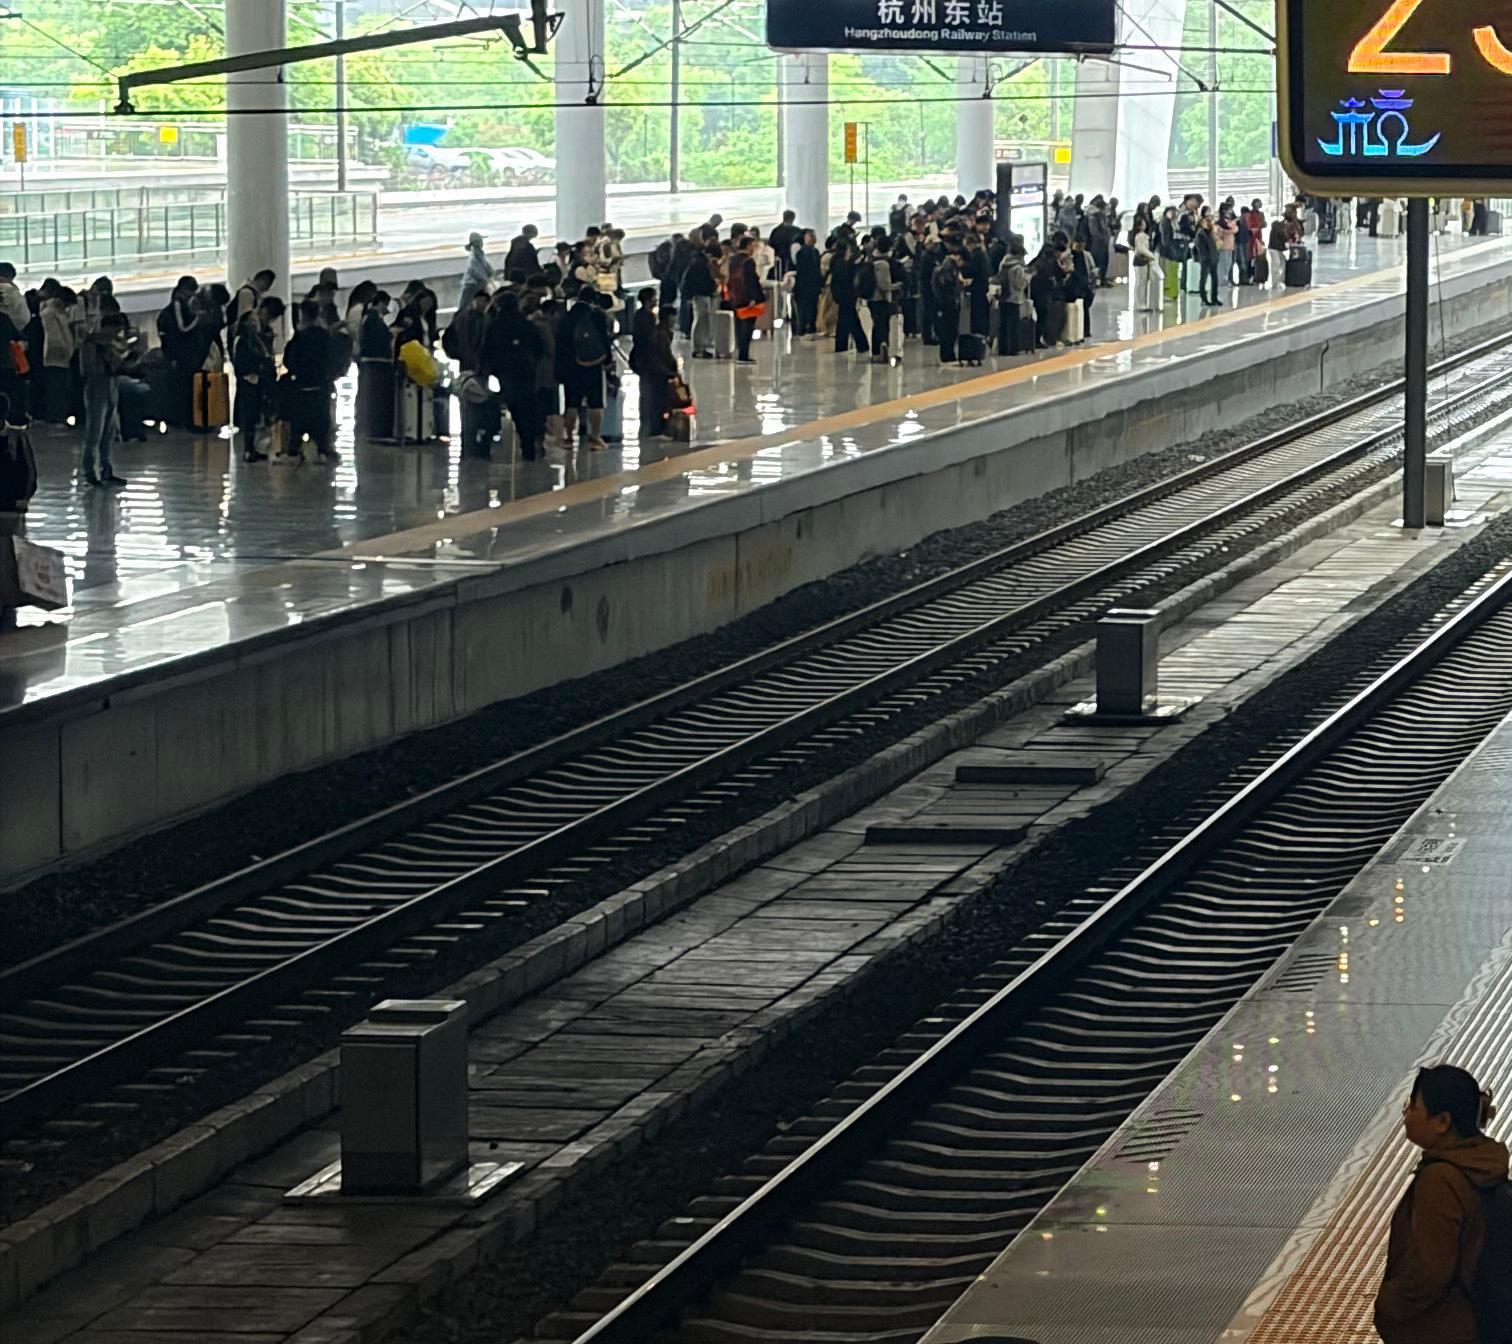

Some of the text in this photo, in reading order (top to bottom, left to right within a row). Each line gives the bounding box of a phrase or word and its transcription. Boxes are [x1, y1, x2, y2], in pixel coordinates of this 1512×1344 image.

[844, 27, 1037, 43] Hangzhoudong Railway Station
